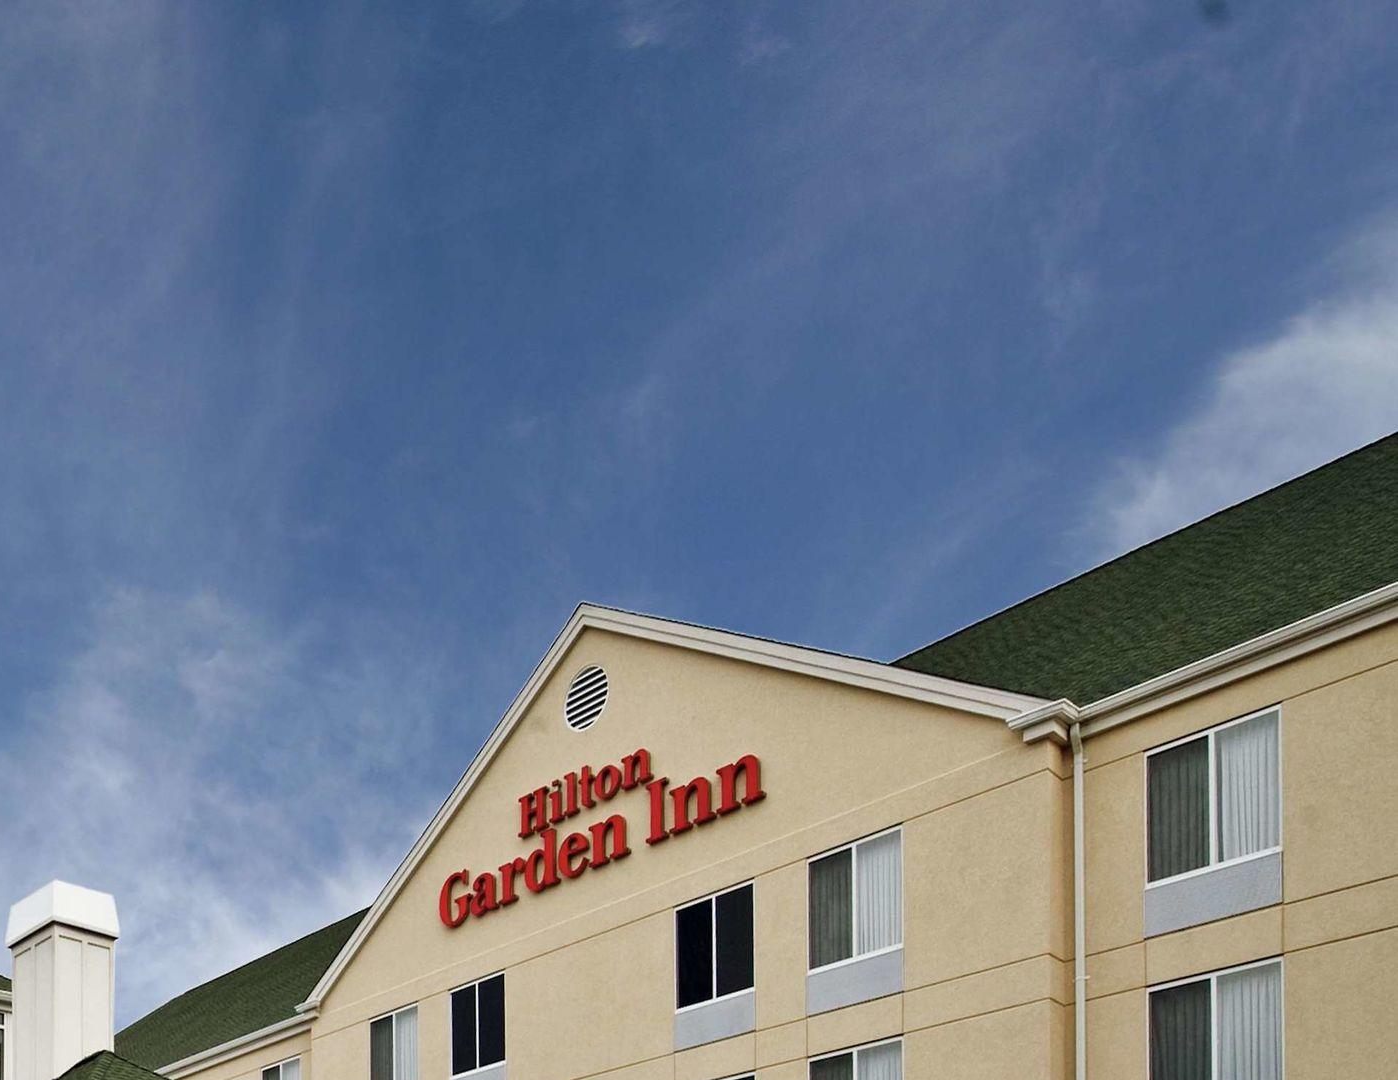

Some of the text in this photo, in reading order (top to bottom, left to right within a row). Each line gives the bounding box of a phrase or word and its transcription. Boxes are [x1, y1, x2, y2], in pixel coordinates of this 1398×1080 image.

[439, 754, 766, 928] Garden Inn
[518, 748, 654, 838] Hilton
